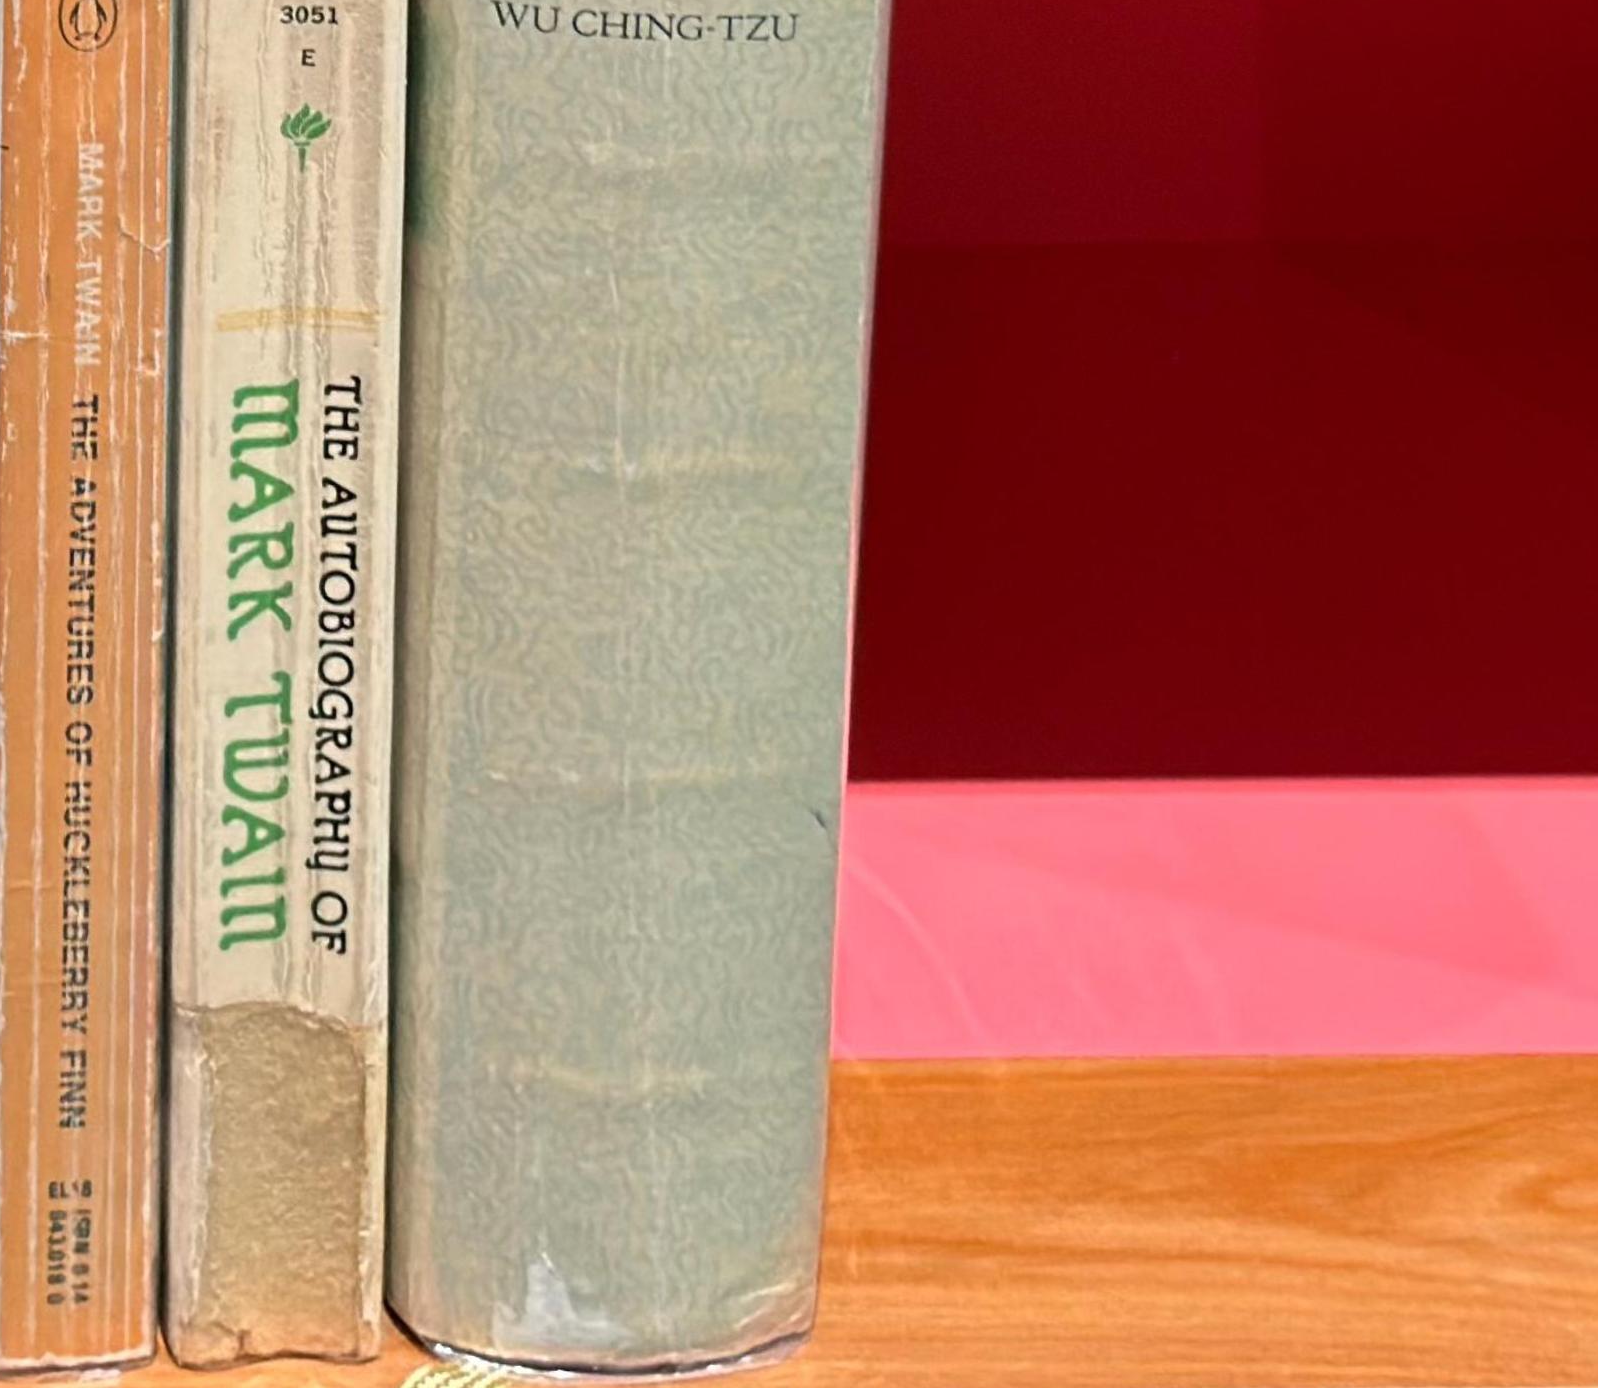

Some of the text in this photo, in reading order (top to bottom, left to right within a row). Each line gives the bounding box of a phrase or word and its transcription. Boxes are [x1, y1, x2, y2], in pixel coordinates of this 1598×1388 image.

[279, 6, 339, 24] 3051
[301, 49, 316, 67] E
[490, 0, 800, 43] WU CHING-TZU
[59, 142, 104, 1129] MARK TWAIN THE ADVENTURES OF HUCKLEBERRY FINN
[218, 378, 300, 952] MARK TWAIN
[304, 375, 360, 956] THE AUTOBIOGRAPHY OF
